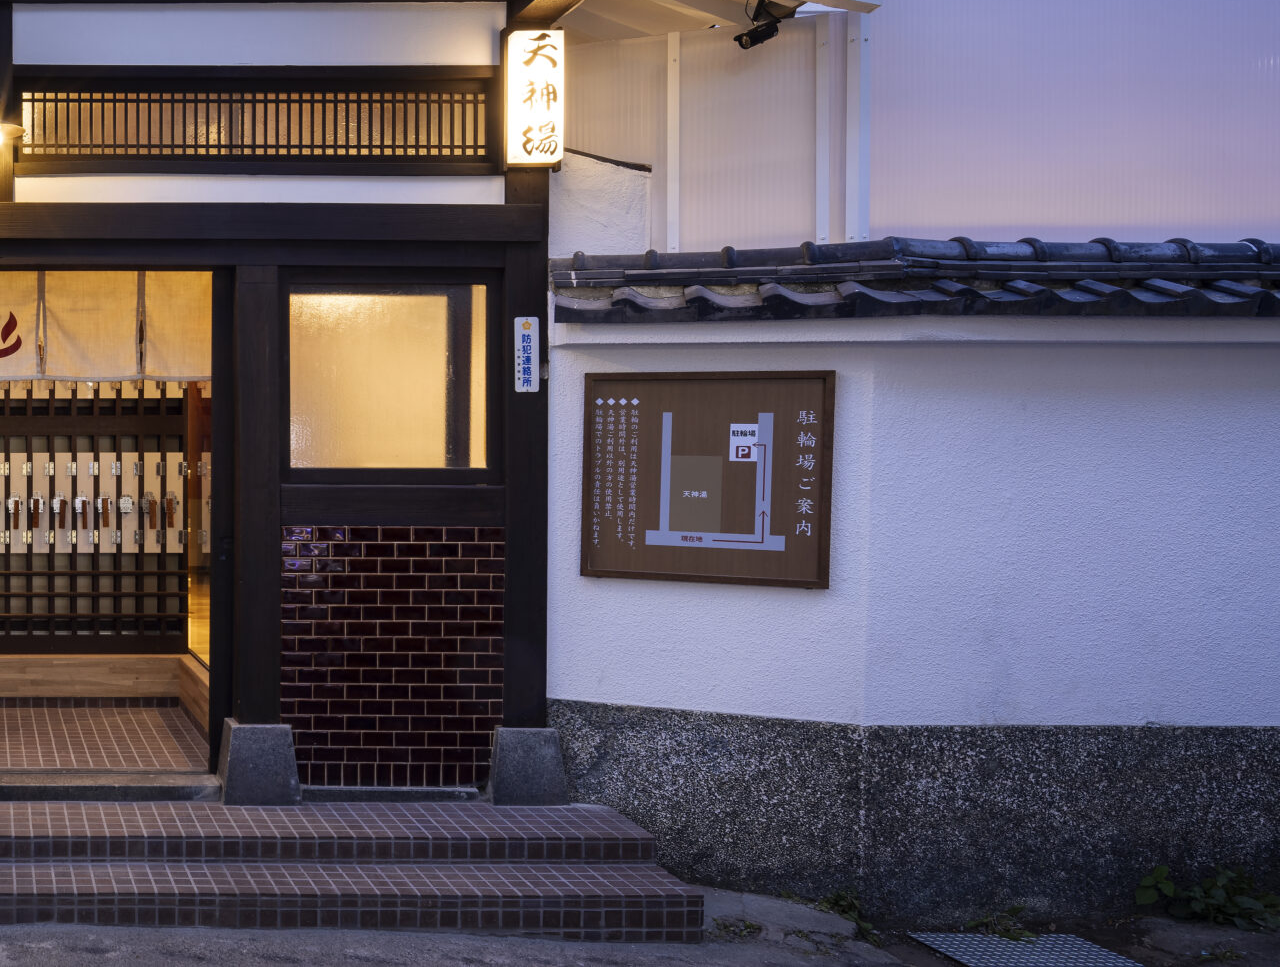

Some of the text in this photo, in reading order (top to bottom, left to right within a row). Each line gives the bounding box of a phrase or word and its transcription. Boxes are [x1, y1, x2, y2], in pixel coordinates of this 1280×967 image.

[522, 33, 558, 156] 天神湯
[522, 334, 532, 388] 防犯連絡所
[732, 430, 756, 438] 駐輪場
[795, 410, 818, 537] 駐輪場ご案内
[683, 490, 708, 498] 天神湯
[681, 535, 703, 543] 現在地
